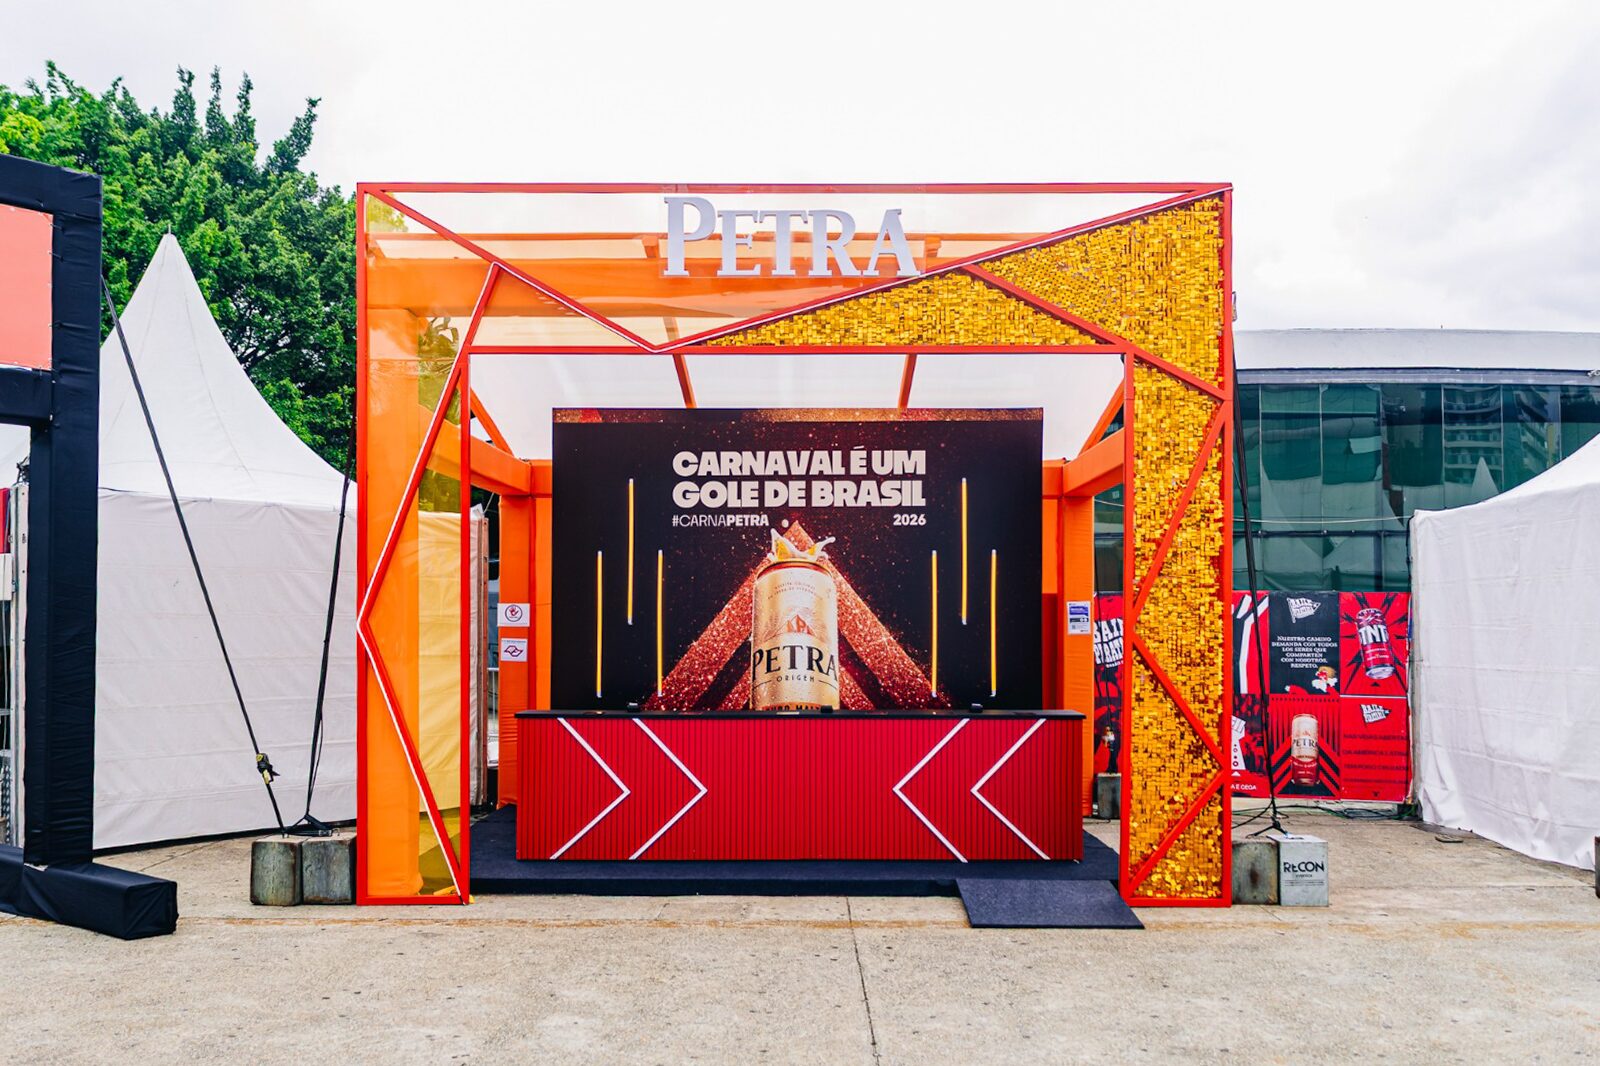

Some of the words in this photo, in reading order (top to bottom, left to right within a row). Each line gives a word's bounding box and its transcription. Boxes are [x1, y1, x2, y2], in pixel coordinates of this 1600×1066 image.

[663, 196, 922, 277] PETRA
[672, 450, 845, 477] CARNAVAL
[850, 445, 867, 475] É
[871, 450, 926, 475] UM
[672, 480, 759, 508] GOLE
[764, 480, 806, 507] DE
[811, 480, 926, 507] BRASIL
[672, 514, 769, 527] #CARNAPETRA
[893, 514, 926, 526] 2026
[1358, 624, 1388, 645] TNT
[752, 645, 838, 683] PETRA
